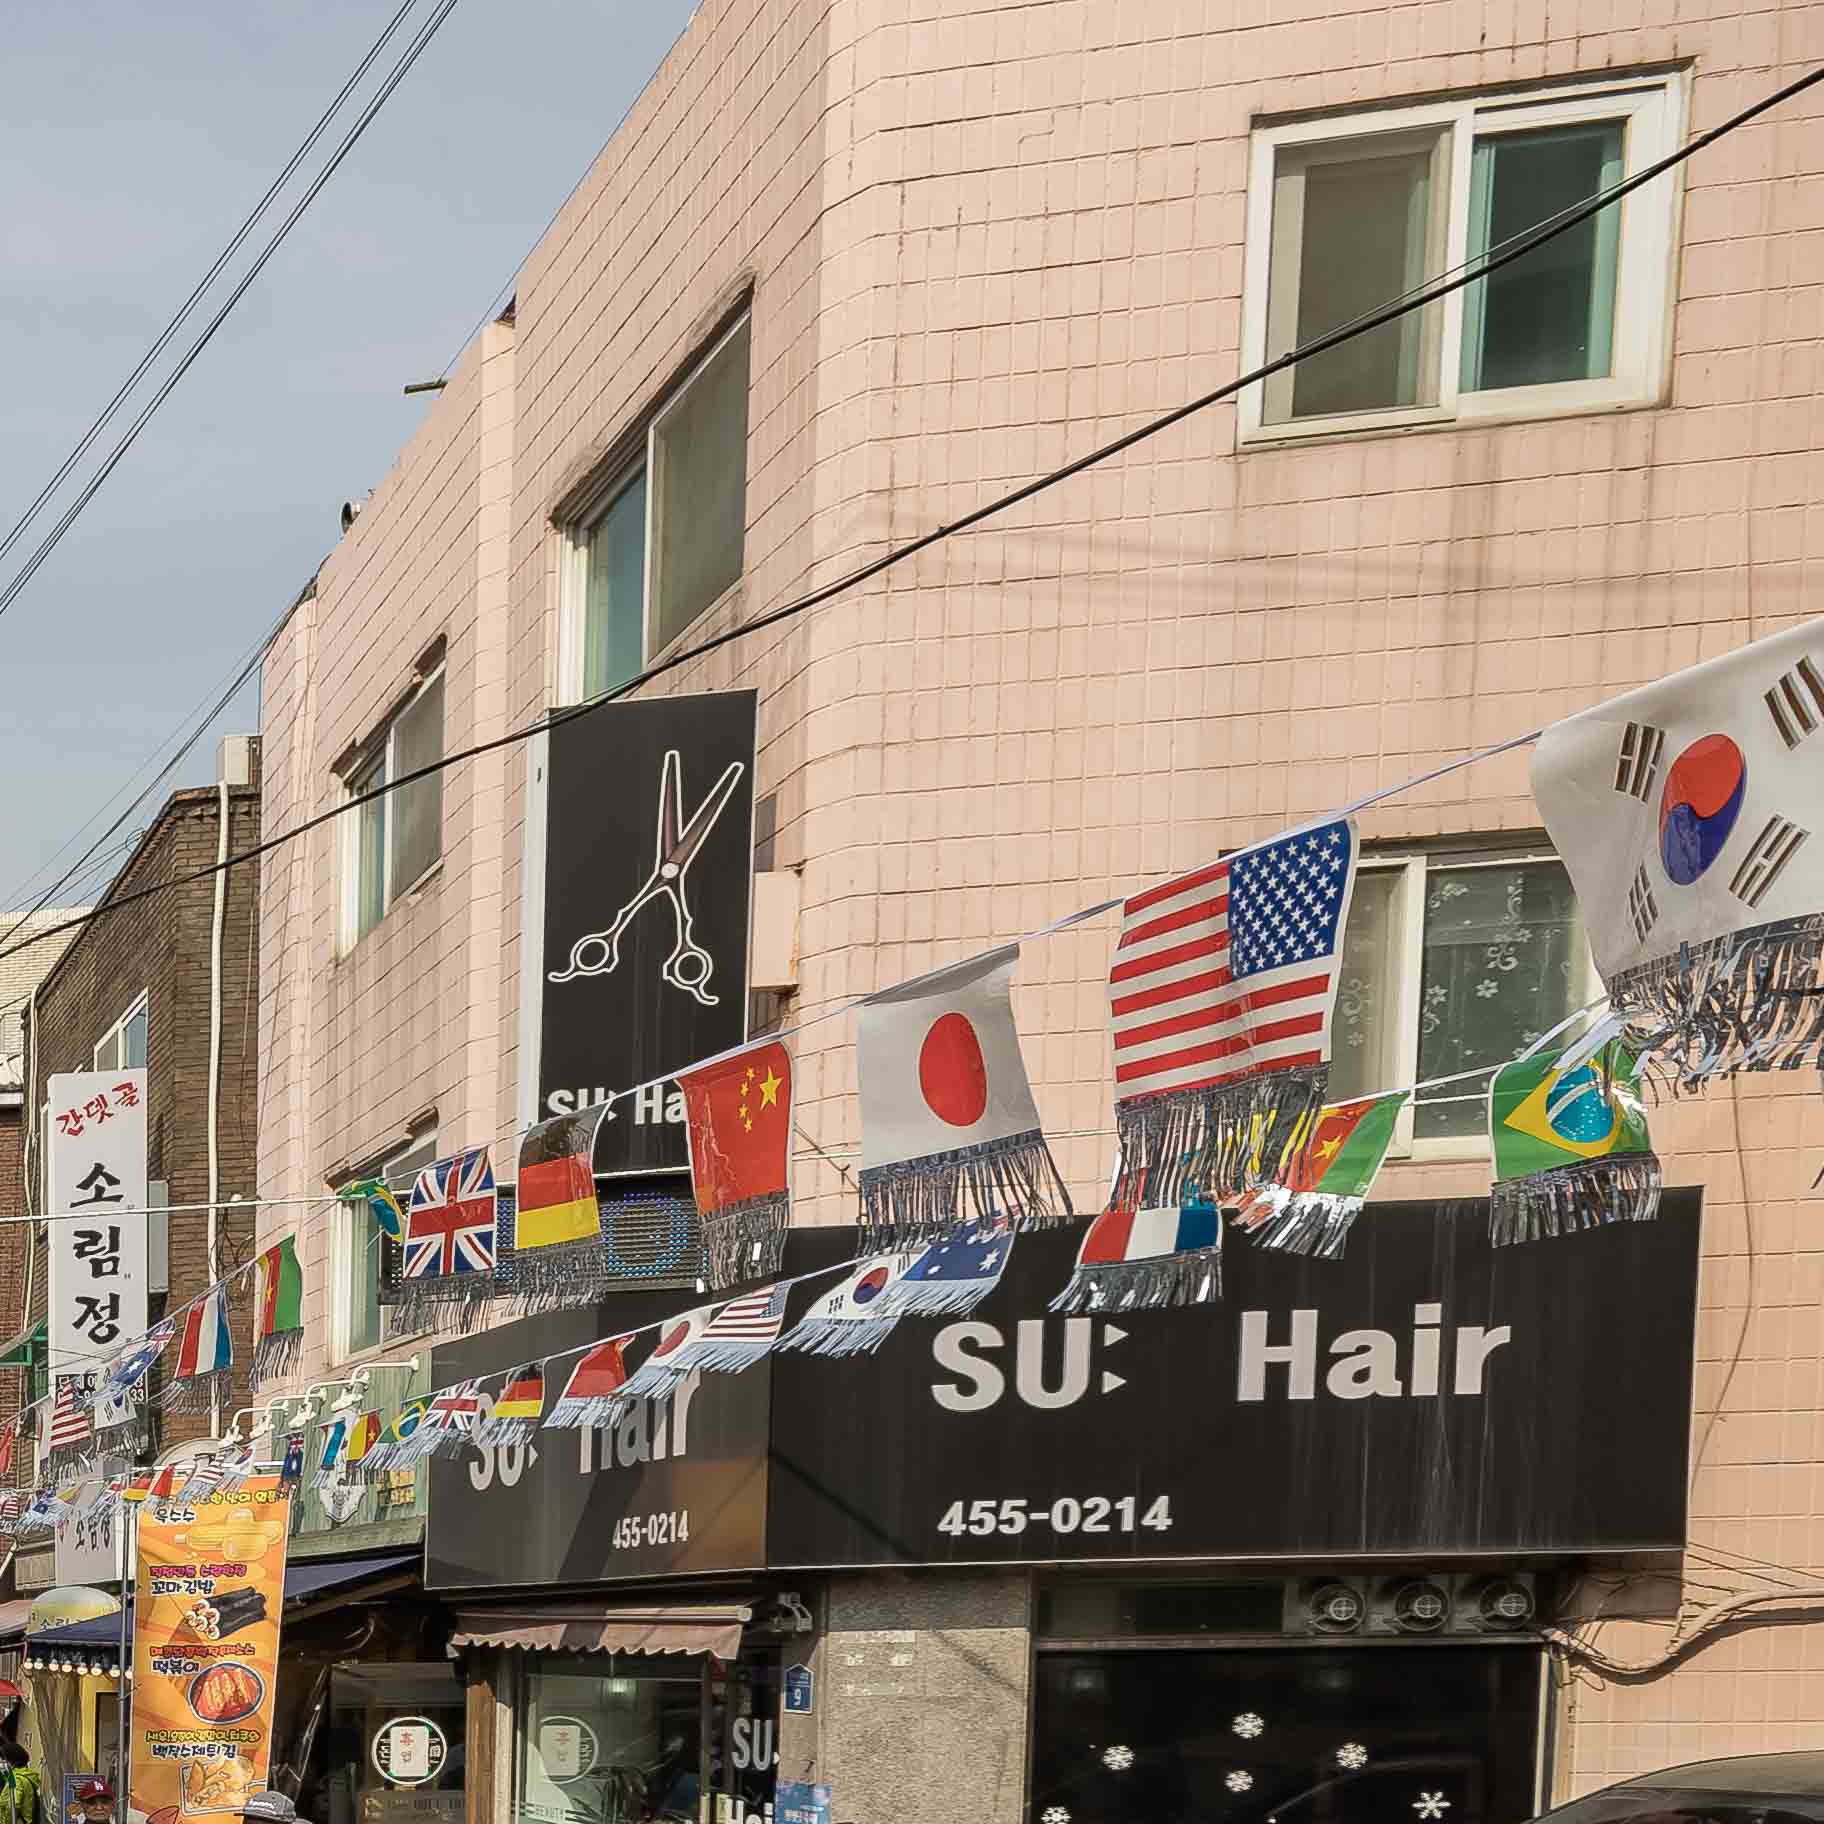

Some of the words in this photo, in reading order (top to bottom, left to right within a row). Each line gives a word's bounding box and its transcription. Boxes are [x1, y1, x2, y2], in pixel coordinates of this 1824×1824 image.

[635, 1083, 687, 1125] Ha
[69, 1161, 125, 1345] 소림정
[1236, 1303, 1512, 1402] Hair
[612, 1511, 689, 1549] 455-0214
[937, 1496, 1173, 1537] 455-0214
